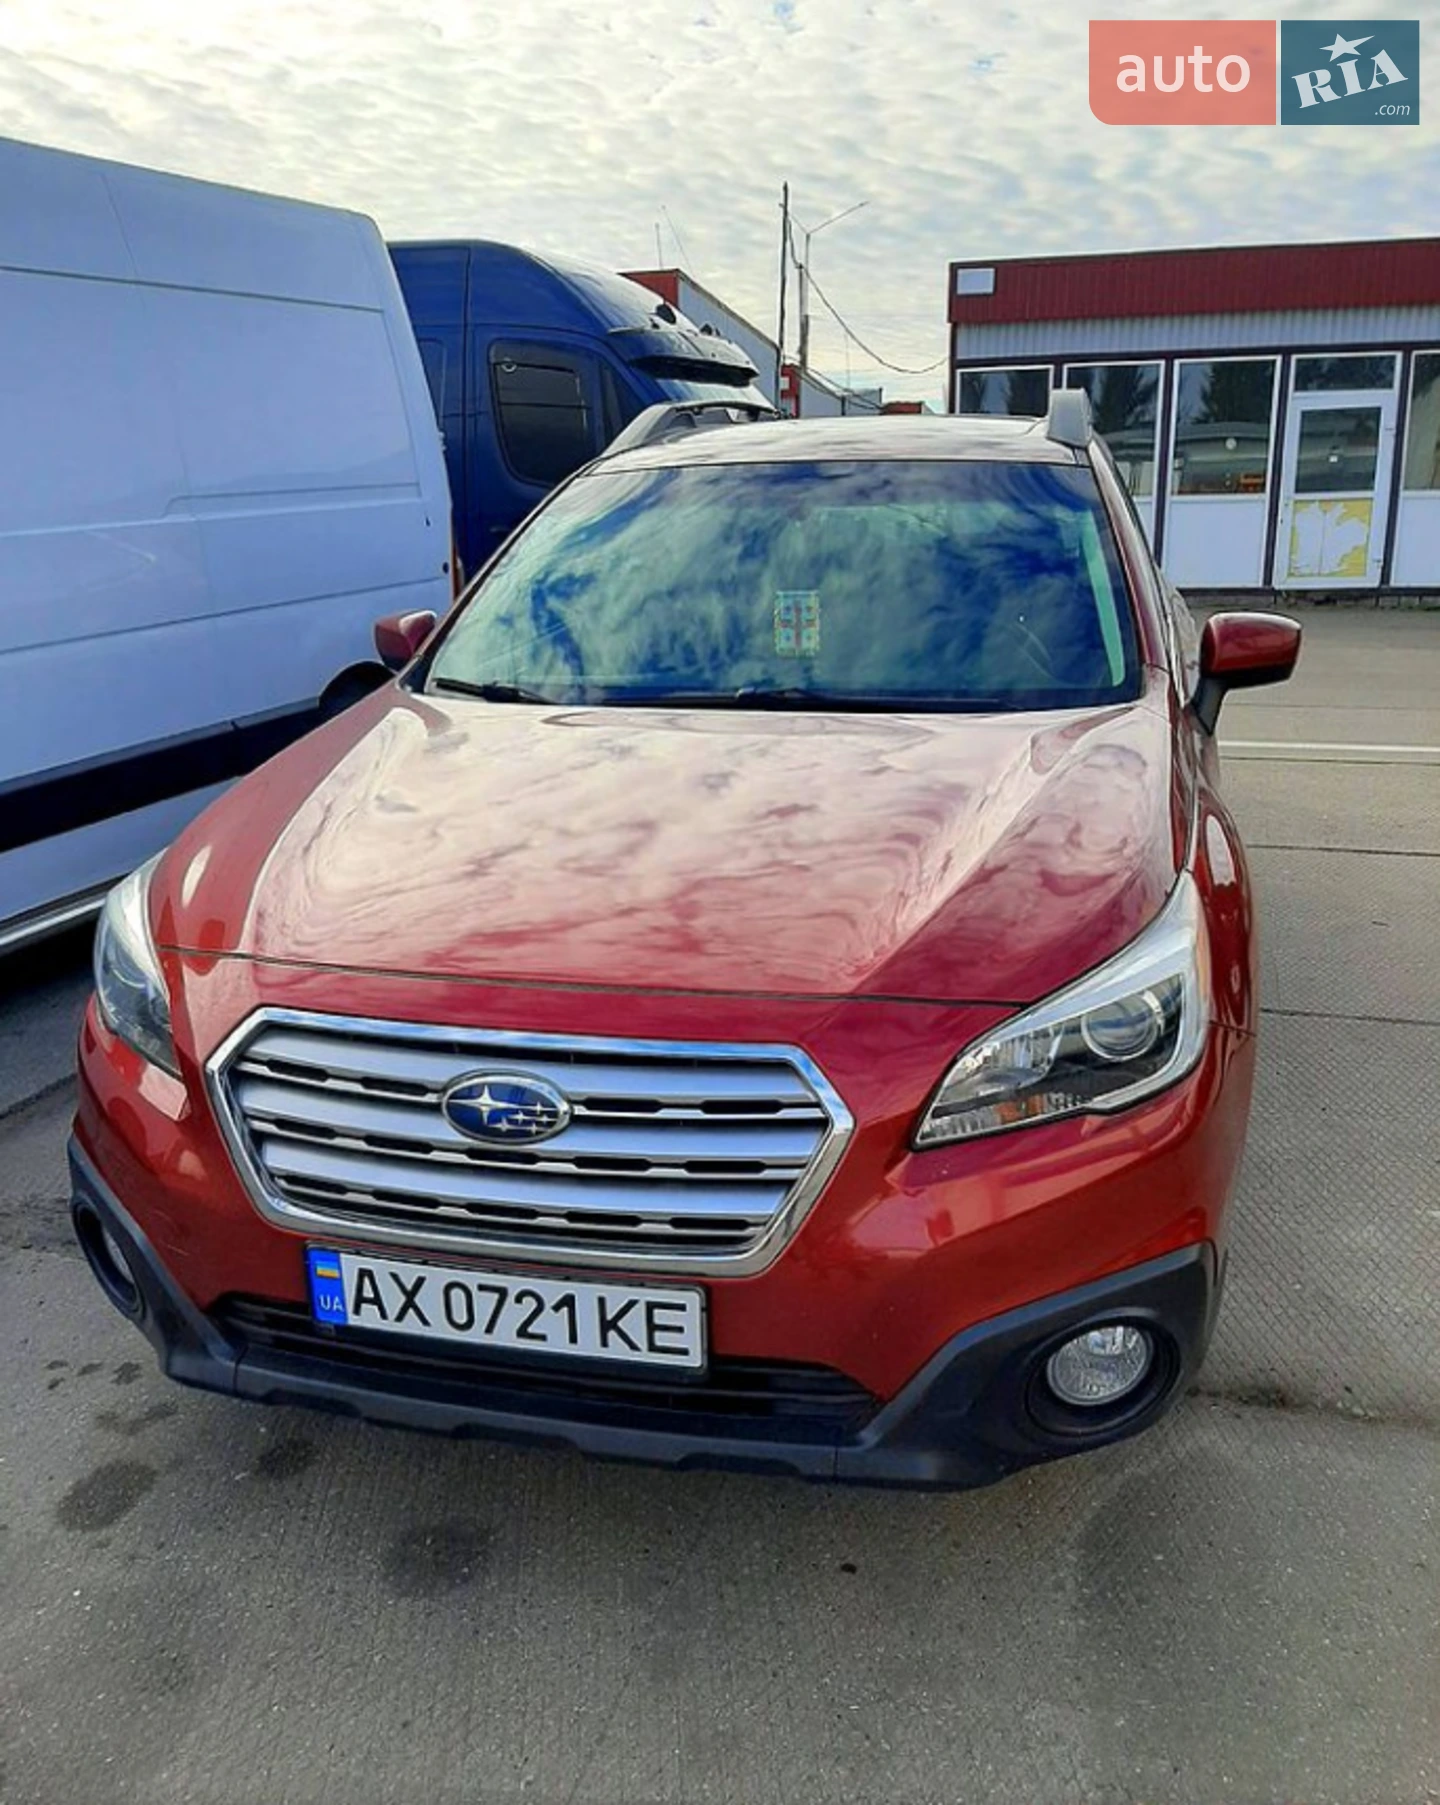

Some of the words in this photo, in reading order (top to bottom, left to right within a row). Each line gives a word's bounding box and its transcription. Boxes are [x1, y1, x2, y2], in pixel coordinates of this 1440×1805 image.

[319, 1294, 344, 1313] UA
[352, 1267, 432, 1328] AX
[442, 1281, 579, 1345] 0721
[598, 1296, 690, 1357] KE
